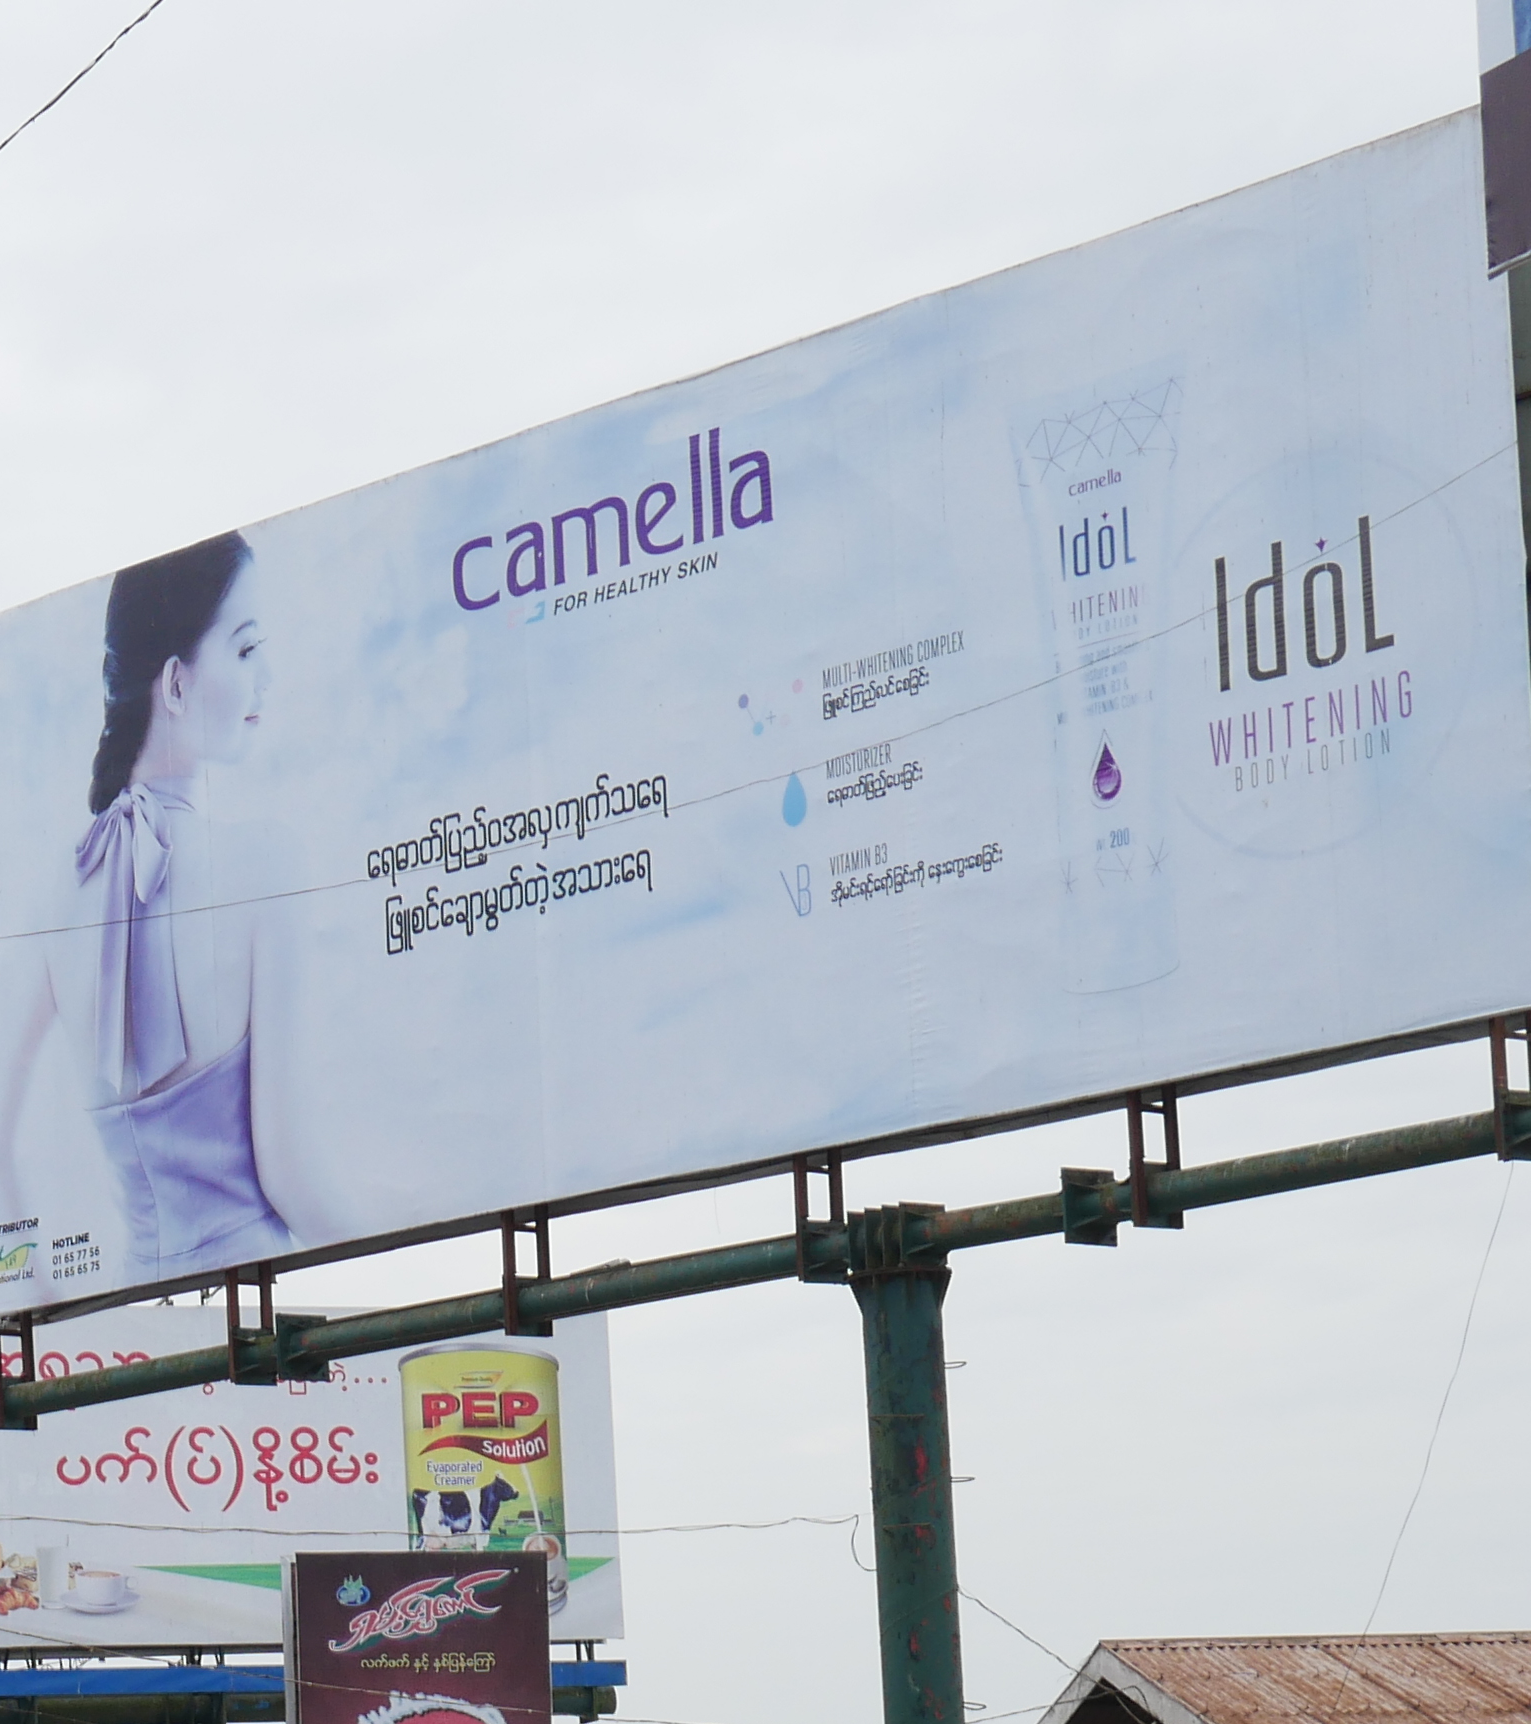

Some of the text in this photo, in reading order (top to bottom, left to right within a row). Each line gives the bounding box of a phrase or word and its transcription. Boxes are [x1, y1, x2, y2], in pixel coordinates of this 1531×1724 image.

[1068, 468, 1122, 497] camella
[452, 427, 774, 611] camella
[553, 552, 719, 616] FOR HEALTHY SKIN
[822, 630, 966, 690] MULTI-WHITENING COMPLEX
[1209, 670, 1412, 767] WHITENING
[826, 742, 893, 780] MOISTURIZER
[1235, 728, 1391, 792] BODY LOTION
[829, 842, 889, 876] VITAMIN B3
[52, 1232, 90, 1250] HOTLINE
[52, 1246, 101, 1266] 01 65 77 56
[52, 1260, 101, 1280] 01 65 65 75
[422, 1391, 539, 1429] PEP
[482, 1436, 547, 1459] Solution
[426, 1460, 483, 1476] Evaporated
[434, 1474, 476, 1487] Creamer
